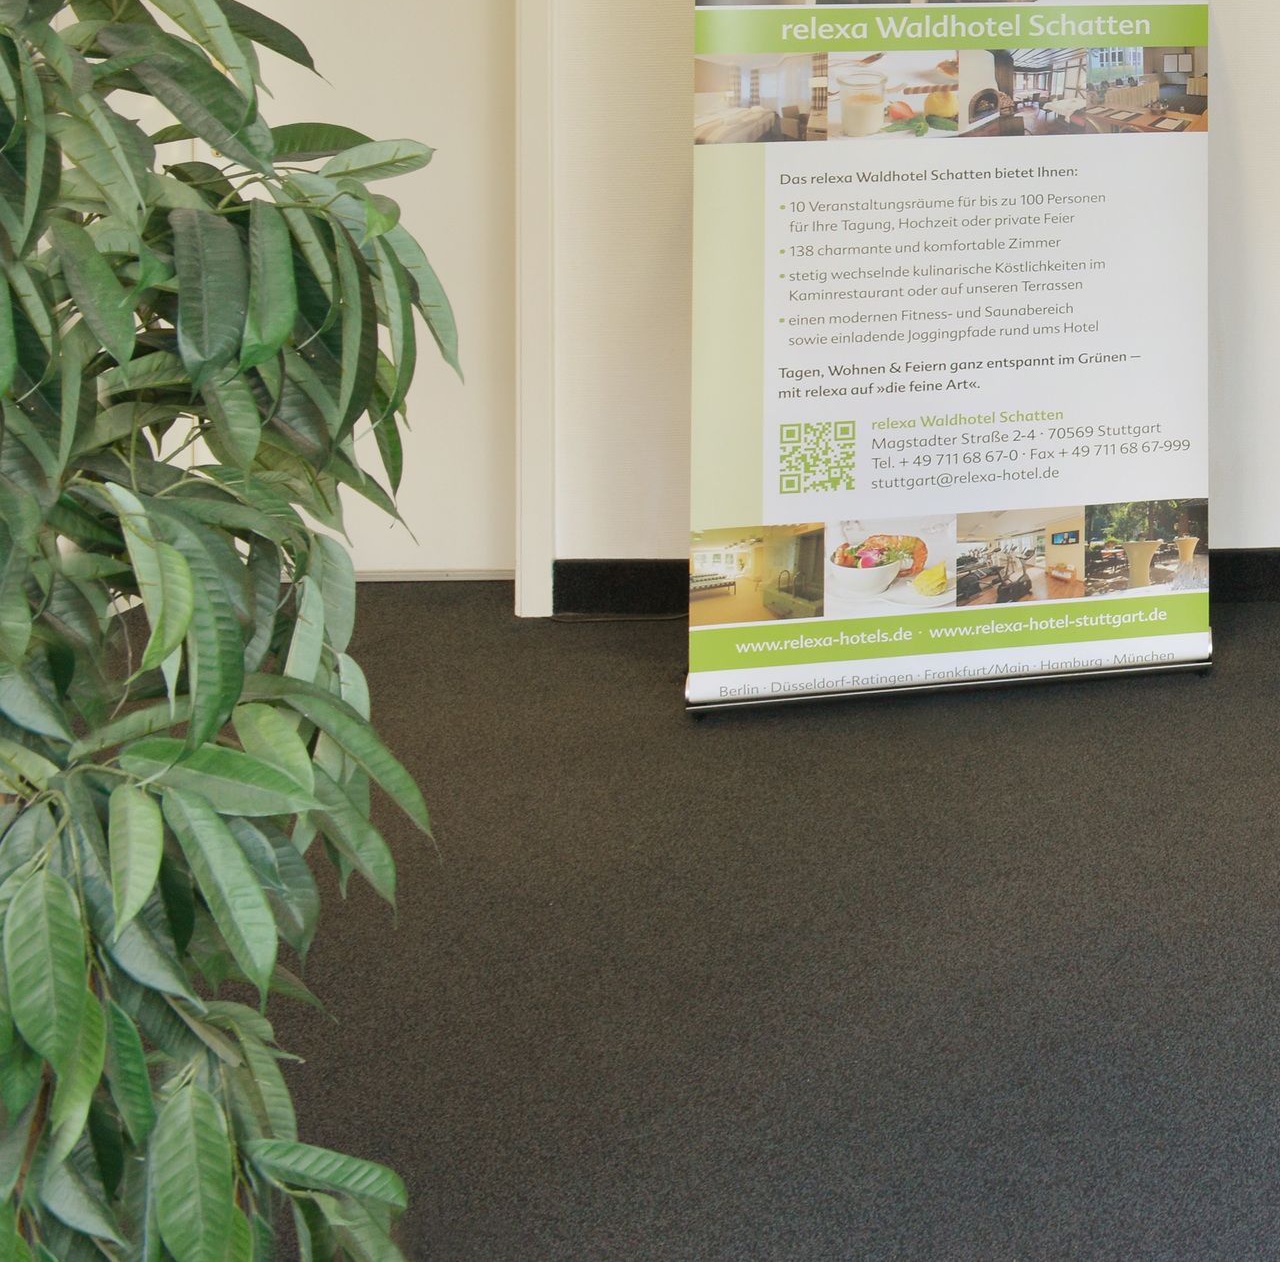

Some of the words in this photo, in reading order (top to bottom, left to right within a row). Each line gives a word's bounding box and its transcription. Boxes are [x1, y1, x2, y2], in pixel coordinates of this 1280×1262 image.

[781, 16, 868, 40] relexa
[875, 13, 1021, 39] Waldhotel
[1027, 12, 1152, 39] Schatten
[780, 173, 808, 185] Das
[810, 172, 853, 184] relexa
[855, 169, 927, 183] Waldhotel
[930, 168, 992, 181] Schatten
[995, 167, 1035, 179] bietet
[1037, 166, 1078, 178] Ihnen:
[789, 201, 806, 213] 10
[808, 198, 955, 213] Veranstaltungsräume
[957, 195, 977, 208] für
[979, 195, 998, 207] bis
[1000, 197, 1017, 207] zu
[1020, 193, 1044, 206] 100
[1047, 193, 1106, 205] Personen
[789, 219, 809, 233] für
[812, 220, 838, 232] Ihre
[840, 219, 895, 234] Tagung,
[898, 216, 958, 229] Hochzeit
[961, 214, 992, 227] oder
[994, 214, 1041, 229] private
[1043, 212, 1075, 224] Feier
[790, 245, 814, 257] 138
[817, 243, 892, 257] charmante
[895, 241, 921, 254] und
[923, 238, 1006, 253] komfortable
[1008, 237, 1062, 250] Zimmer
[788, 269, 828, 284] stetig
[830, 265, 910, 280] wechselnde
[912, 262, 992, 277] kulinarische
[995, 259, 1087, 274] Köstlichkeiten
[1089, 258, 1106, 270] im
[789, 287, 905, 302] Kaminrestaurant
[907, 284, 938, 297] oder
[940, 282, 964, 296] auf
[966, 283, 1018, 295] unseren
[1021, 280, 1083, 292] Terrassen
[788, 314, 826, 326] einen
[828, 311, 898, 325] modernen
[901, 309, 953, 321] Fitness-
[956, 305, 981, 319] und
[984, 302, 1074, 318] Saunabereich
[788, 333, 828, 347] sowie
[830, 329, 905, 344] einladende
[906, 325, 997, 344] Joggingpfade
[999, 323, 1030, 337] rund
[1032, 325, 1061, 335] ums
[1063, 319, 1099, 334] Hotel
[778, 367, 825, 382] Tagen,
[827, 363, 886, 377] Wohnen
[889, 362, 902, 374] &
[905, 360, 947, 373] Feiern
[949, 361, 984, 374] ganz
[986, 355, 1055, 370] entspannt
[1058, 354, 1075, 365] im
[1077, 351, 1128, 365] Grünen
[778, 386, 802, 399] mit
[805, 385, 847, 398] relexa
[850, 382, 877, 396] auf
[908, 380, 943, 393] feine
[871, 417, 916, 431] relexa
[919, 412, 997, 428] Waldhotel
[999, 410, 1064, 423] Schatten
[871, 434, 958, 452] Magstadter
[961, 430, 1009, 445] Straße
[1012, 429, 1036, 442] 2-4
[1047, 425, 1094, 440] 70569
[1097, 423, 1161, 438] Stuttgart
[871, 456, 896, 470] Tel.
[912, 454, 932, 467] 49
[936, 452, 958, 466] 711
[962, 451, 982, 464] 68
[985, 449, 1019, 463] 67-0
[1030, 448, 1055, 460] Fax
[1071, 445, 1090, 458] 49
[1093, 443, 1116, 457] 711
[1119, 441, 1138, 455] 68
[1141, 439, 1191, 453] 67-999
[870, 466, 1061, 491] stuttgart@relexa-hotel.de
[735, 626, 914, 654] www.relexa-hotels.de
[928, 606, 1169, 640] www.relexa-hotel-stuttgart.de
[718, 683, 761, 699] Berlin
[770, 673, 915, 695] Düsseldorf-Ratingen
[923, 662, 1031, 682] Frankfurt/Main
[1039, 656, 1104, 673] Hamburg
[1112, 650, 1177, 666] München
